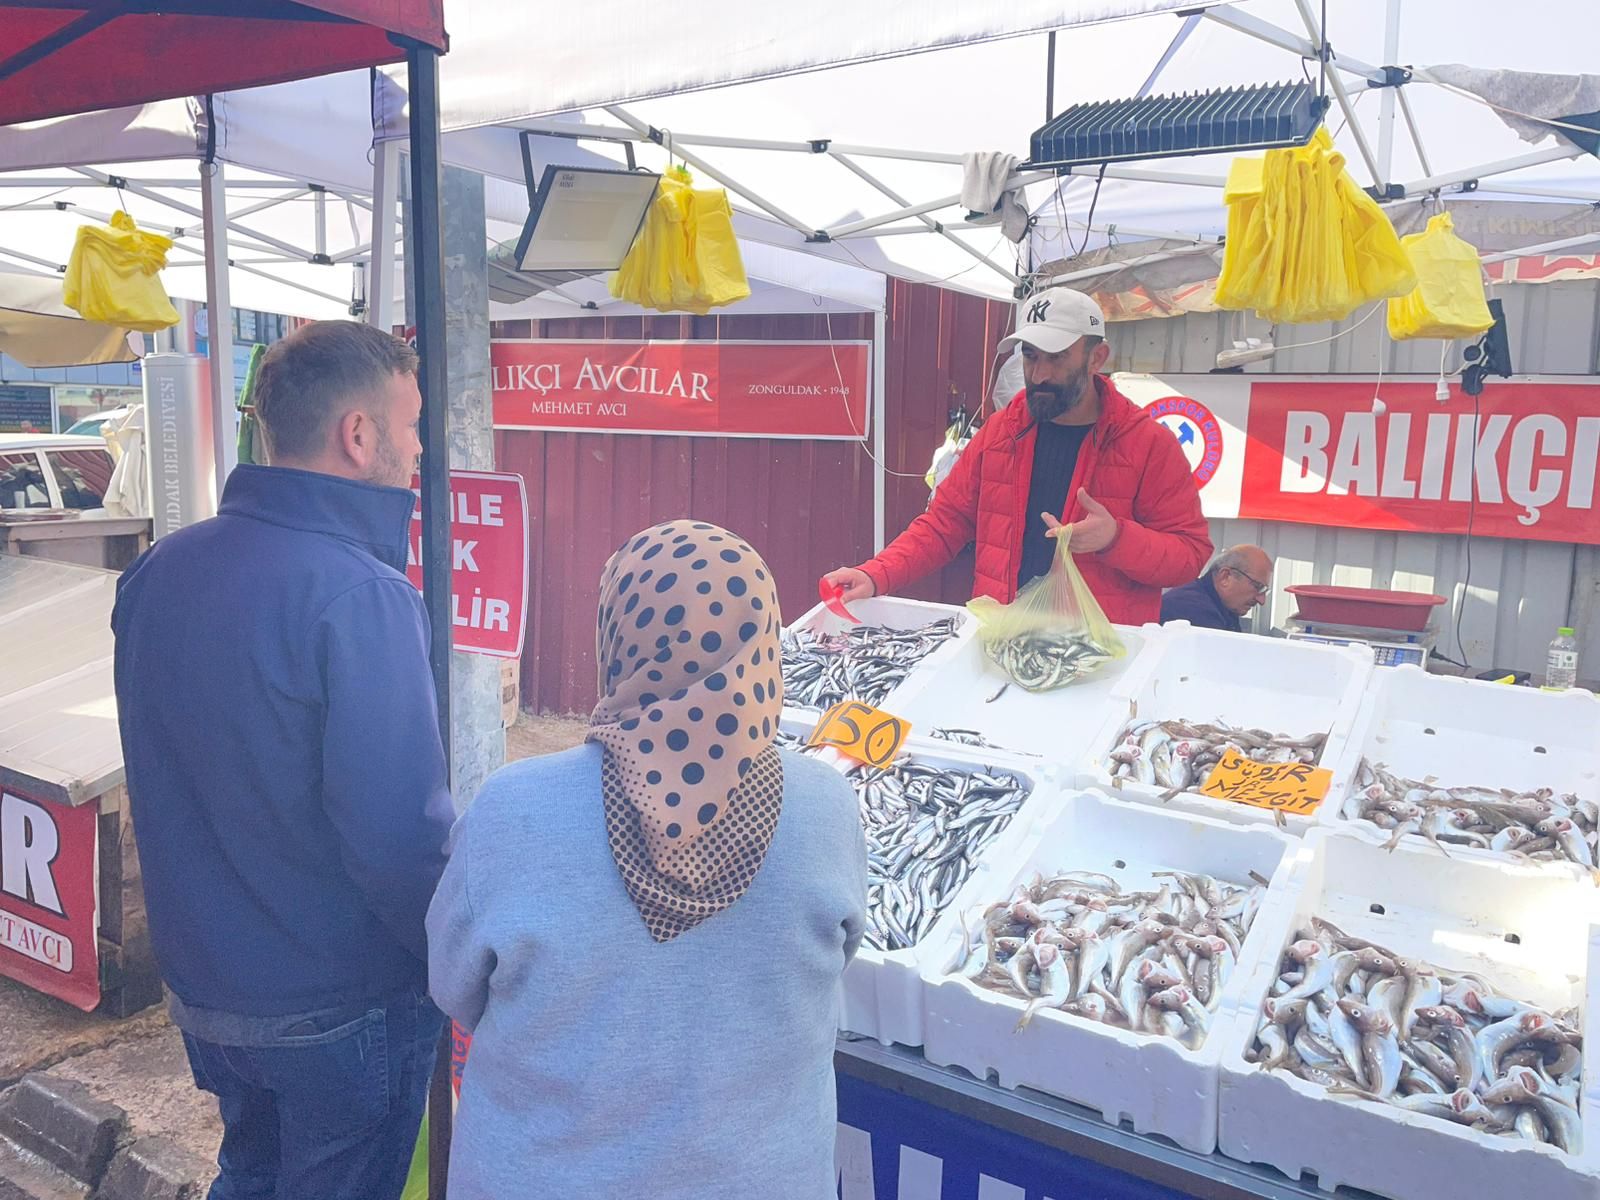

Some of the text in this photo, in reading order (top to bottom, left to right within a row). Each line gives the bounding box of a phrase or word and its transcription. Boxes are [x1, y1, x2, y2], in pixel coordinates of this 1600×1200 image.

[574, 357, 713, 402] AVCILAR
[748, 384, 822, 396] ZONGULDAK
[531, 401, 627, 416] MEHMET AVCI
[1280, 410, 1600, 526] BALIKÇI
[18, 924, 62, 964] AVCI
